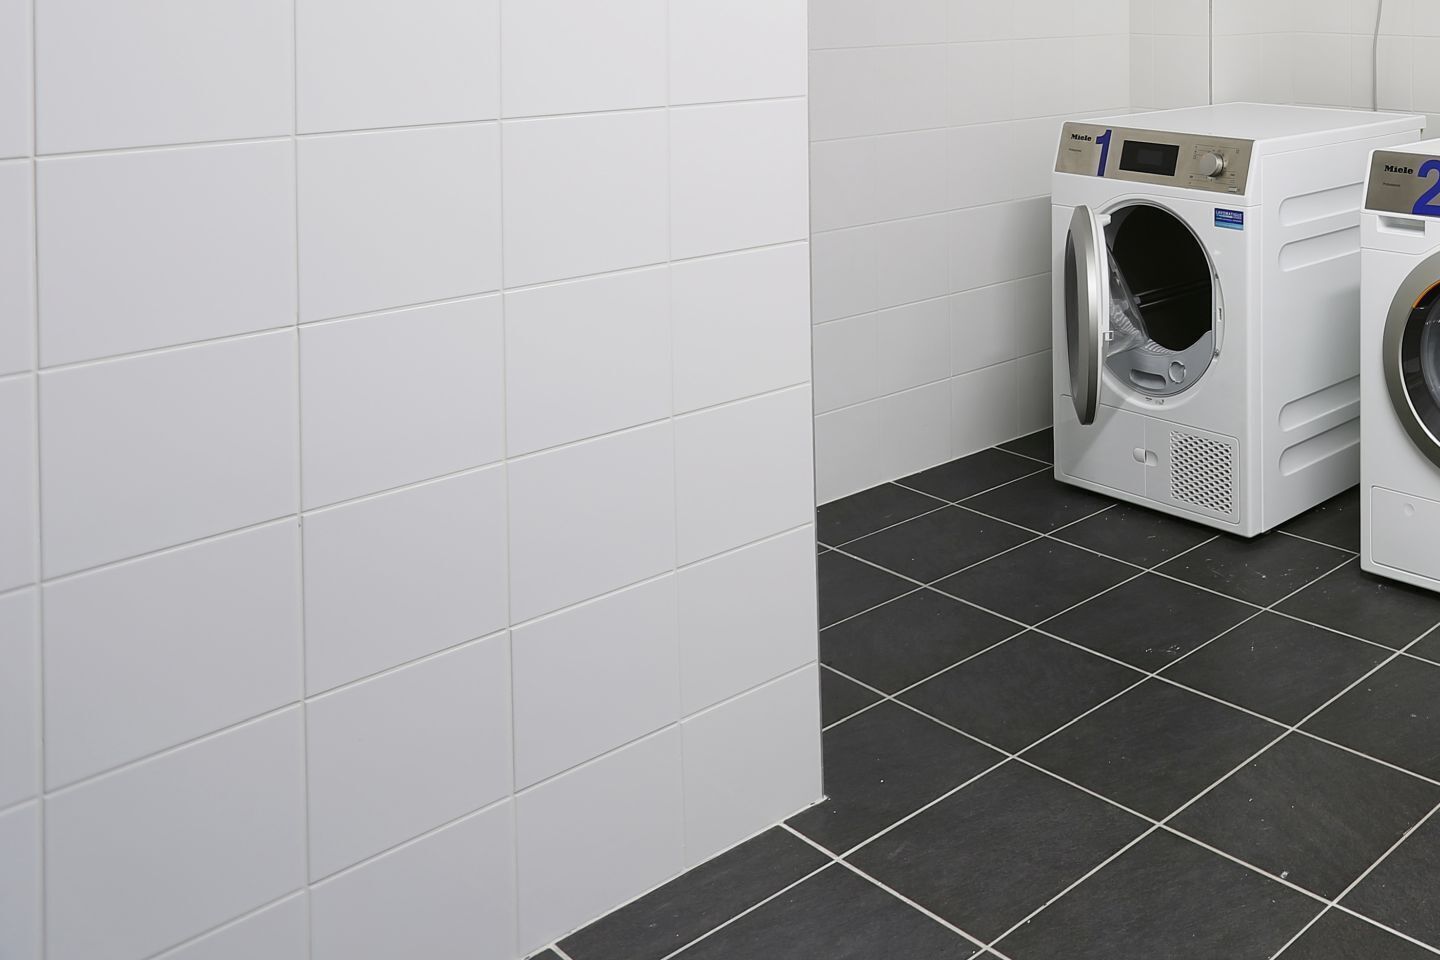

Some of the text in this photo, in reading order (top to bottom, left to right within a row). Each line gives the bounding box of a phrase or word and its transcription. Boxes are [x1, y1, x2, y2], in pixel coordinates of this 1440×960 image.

[1070, 129, 1112, 177] Miele 1
[1384, 165, 1414, 175] Miele
